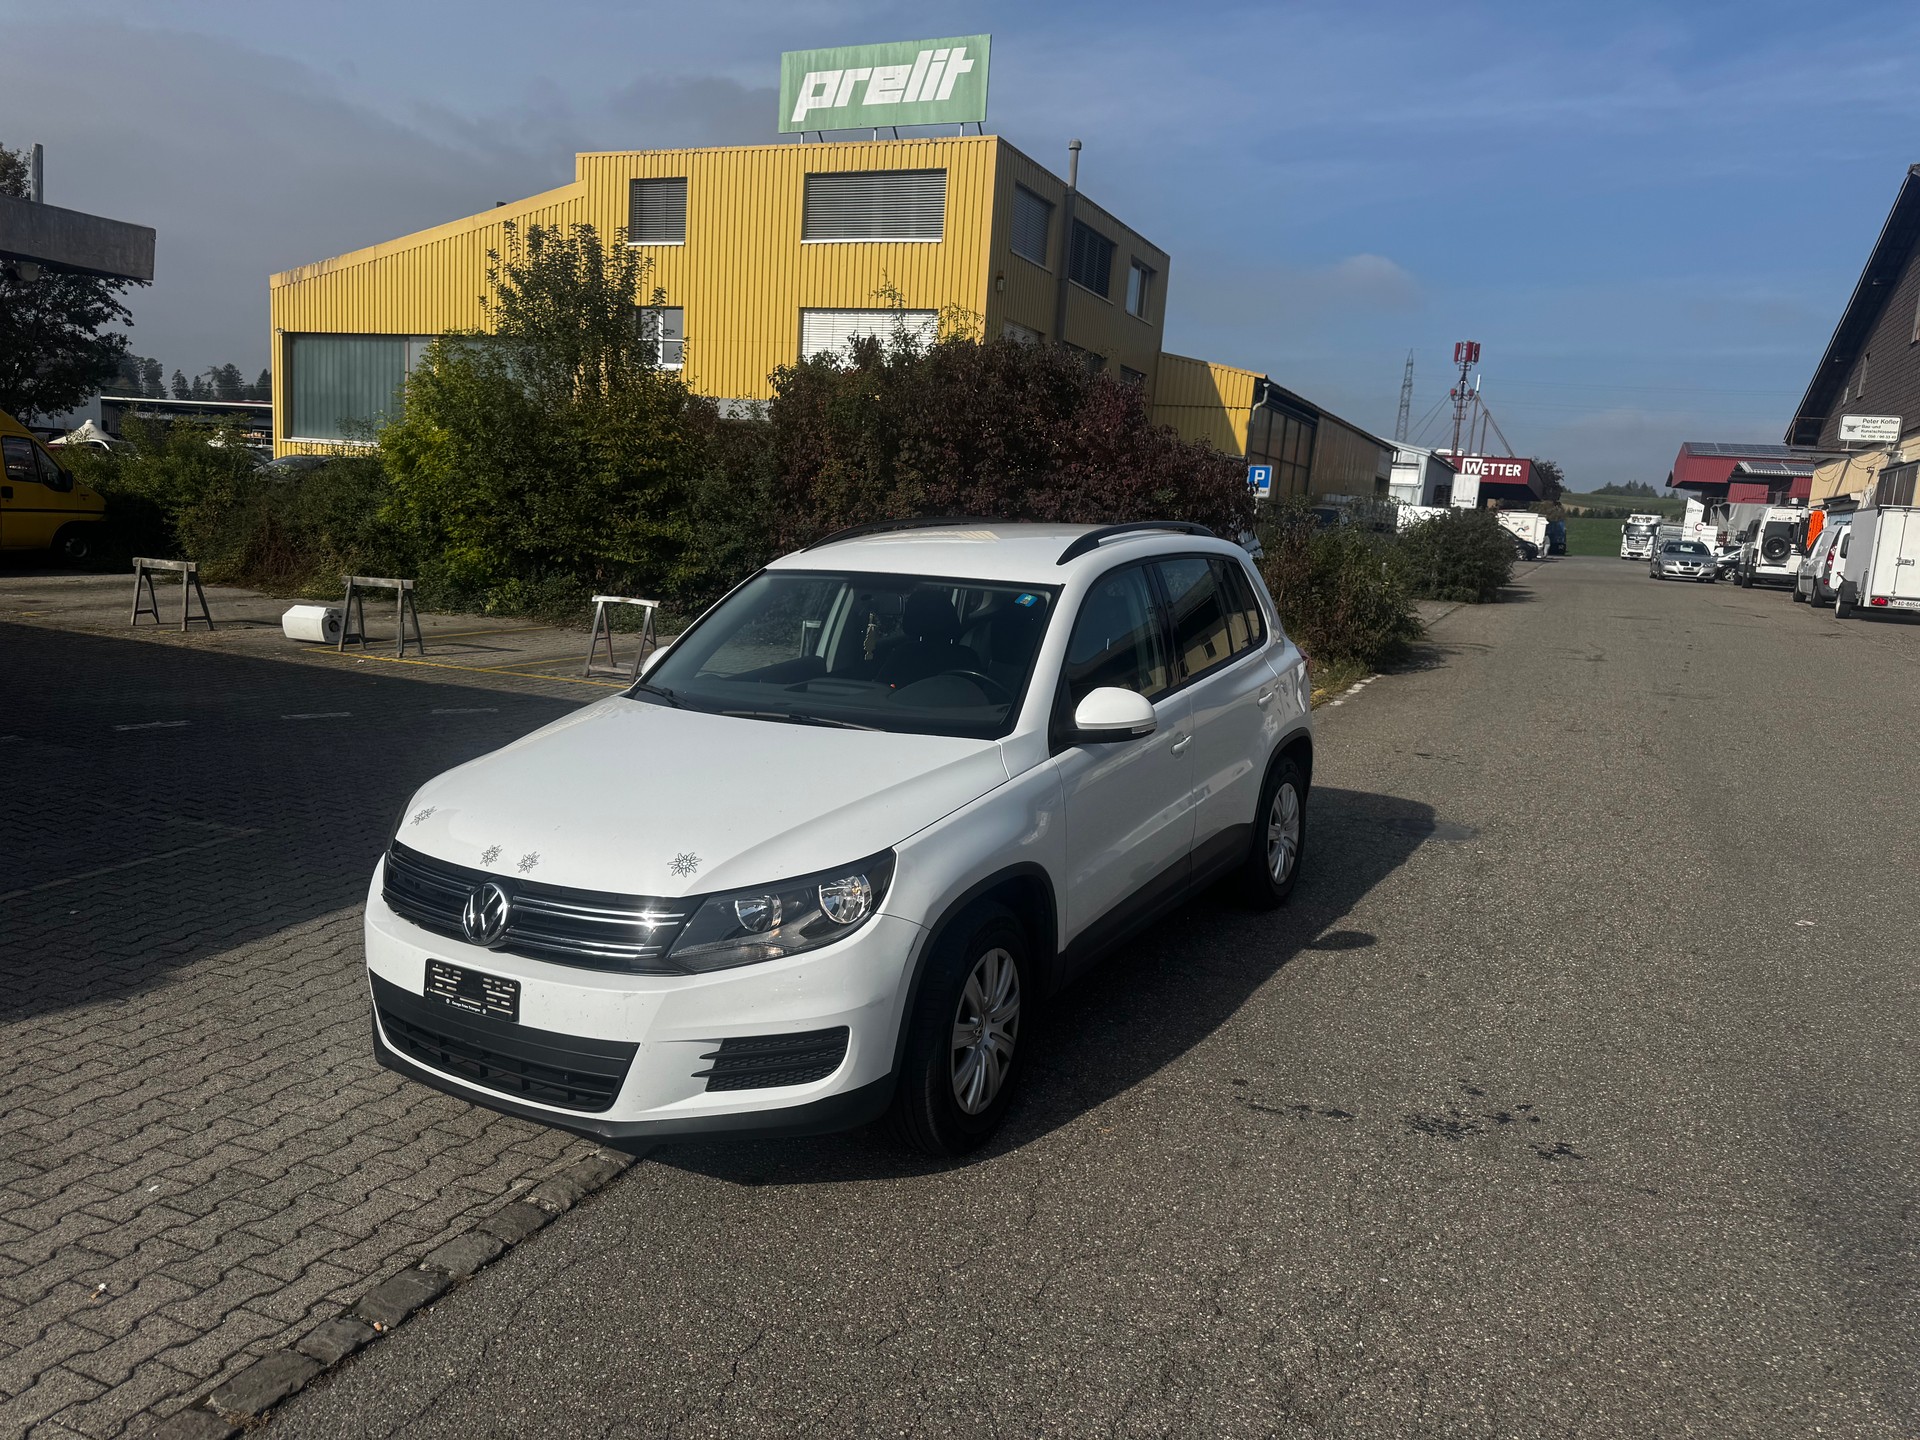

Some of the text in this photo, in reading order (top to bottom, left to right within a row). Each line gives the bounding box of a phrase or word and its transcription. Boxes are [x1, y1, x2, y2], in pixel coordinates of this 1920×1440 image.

[791, 47, 975, 122] prelit
[1254, 469, 1266, 485] P
[1464, 459, 1522, 477] WETTER
